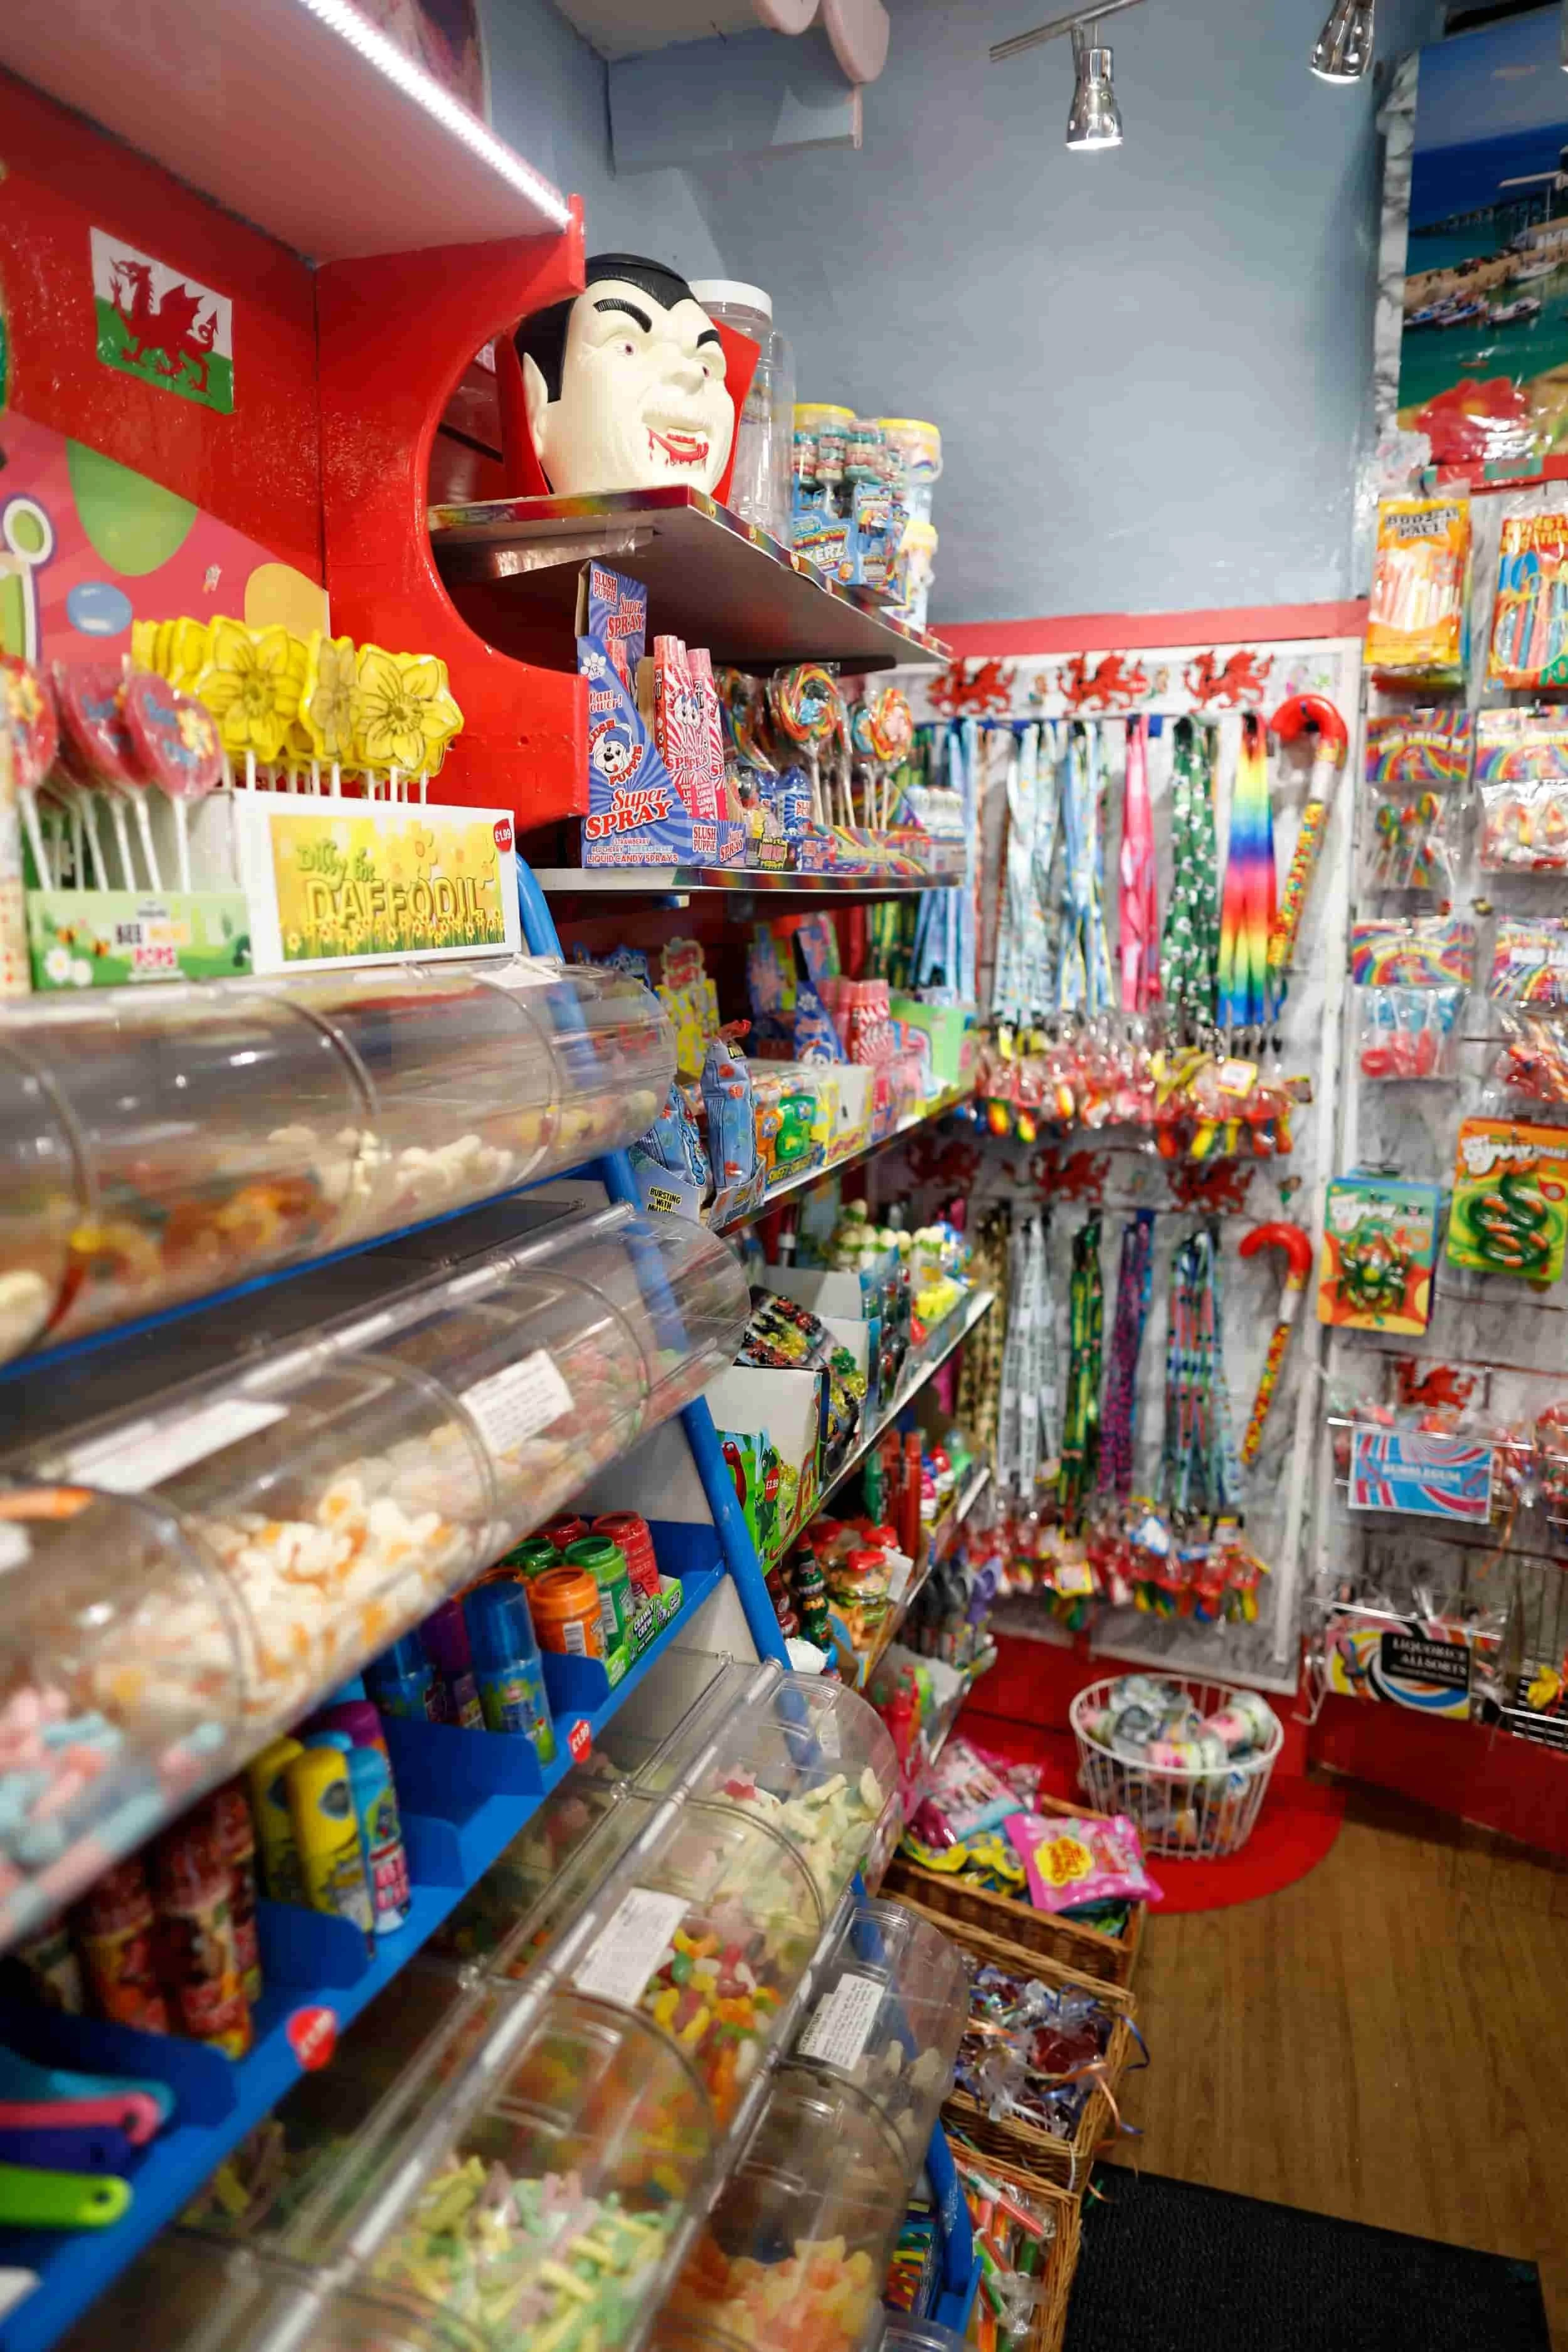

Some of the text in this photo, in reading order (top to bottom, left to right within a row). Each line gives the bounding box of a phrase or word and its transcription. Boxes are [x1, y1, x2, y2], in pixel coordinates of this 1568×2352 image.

[593, 571, 617, 590] SLUSH
[593, 584, 617, 604] PUPPIE
[620, 593, 643, 615] Super
[607, 614, 644, 638] SPRAY
[590, 694, 623, 713] ower!
[609, 744, 643, 785] PUPPIE
[613, 788, 667, 812] Super
[585, 800, 672, 839] SPRAY
[494, 828, 512, 843] £1.99
[693, 825, 716, 840] SLUSH
[693, 840, 716, 853] PUPPIE
[720, 838, 743, 862] SPRAY
[587, 853, 679, 864] LIQUID CANDY SPRAYS
[307, 877, 485, 926] DAFFODIL
[650, 1187, 681, 1204] BURSTING
